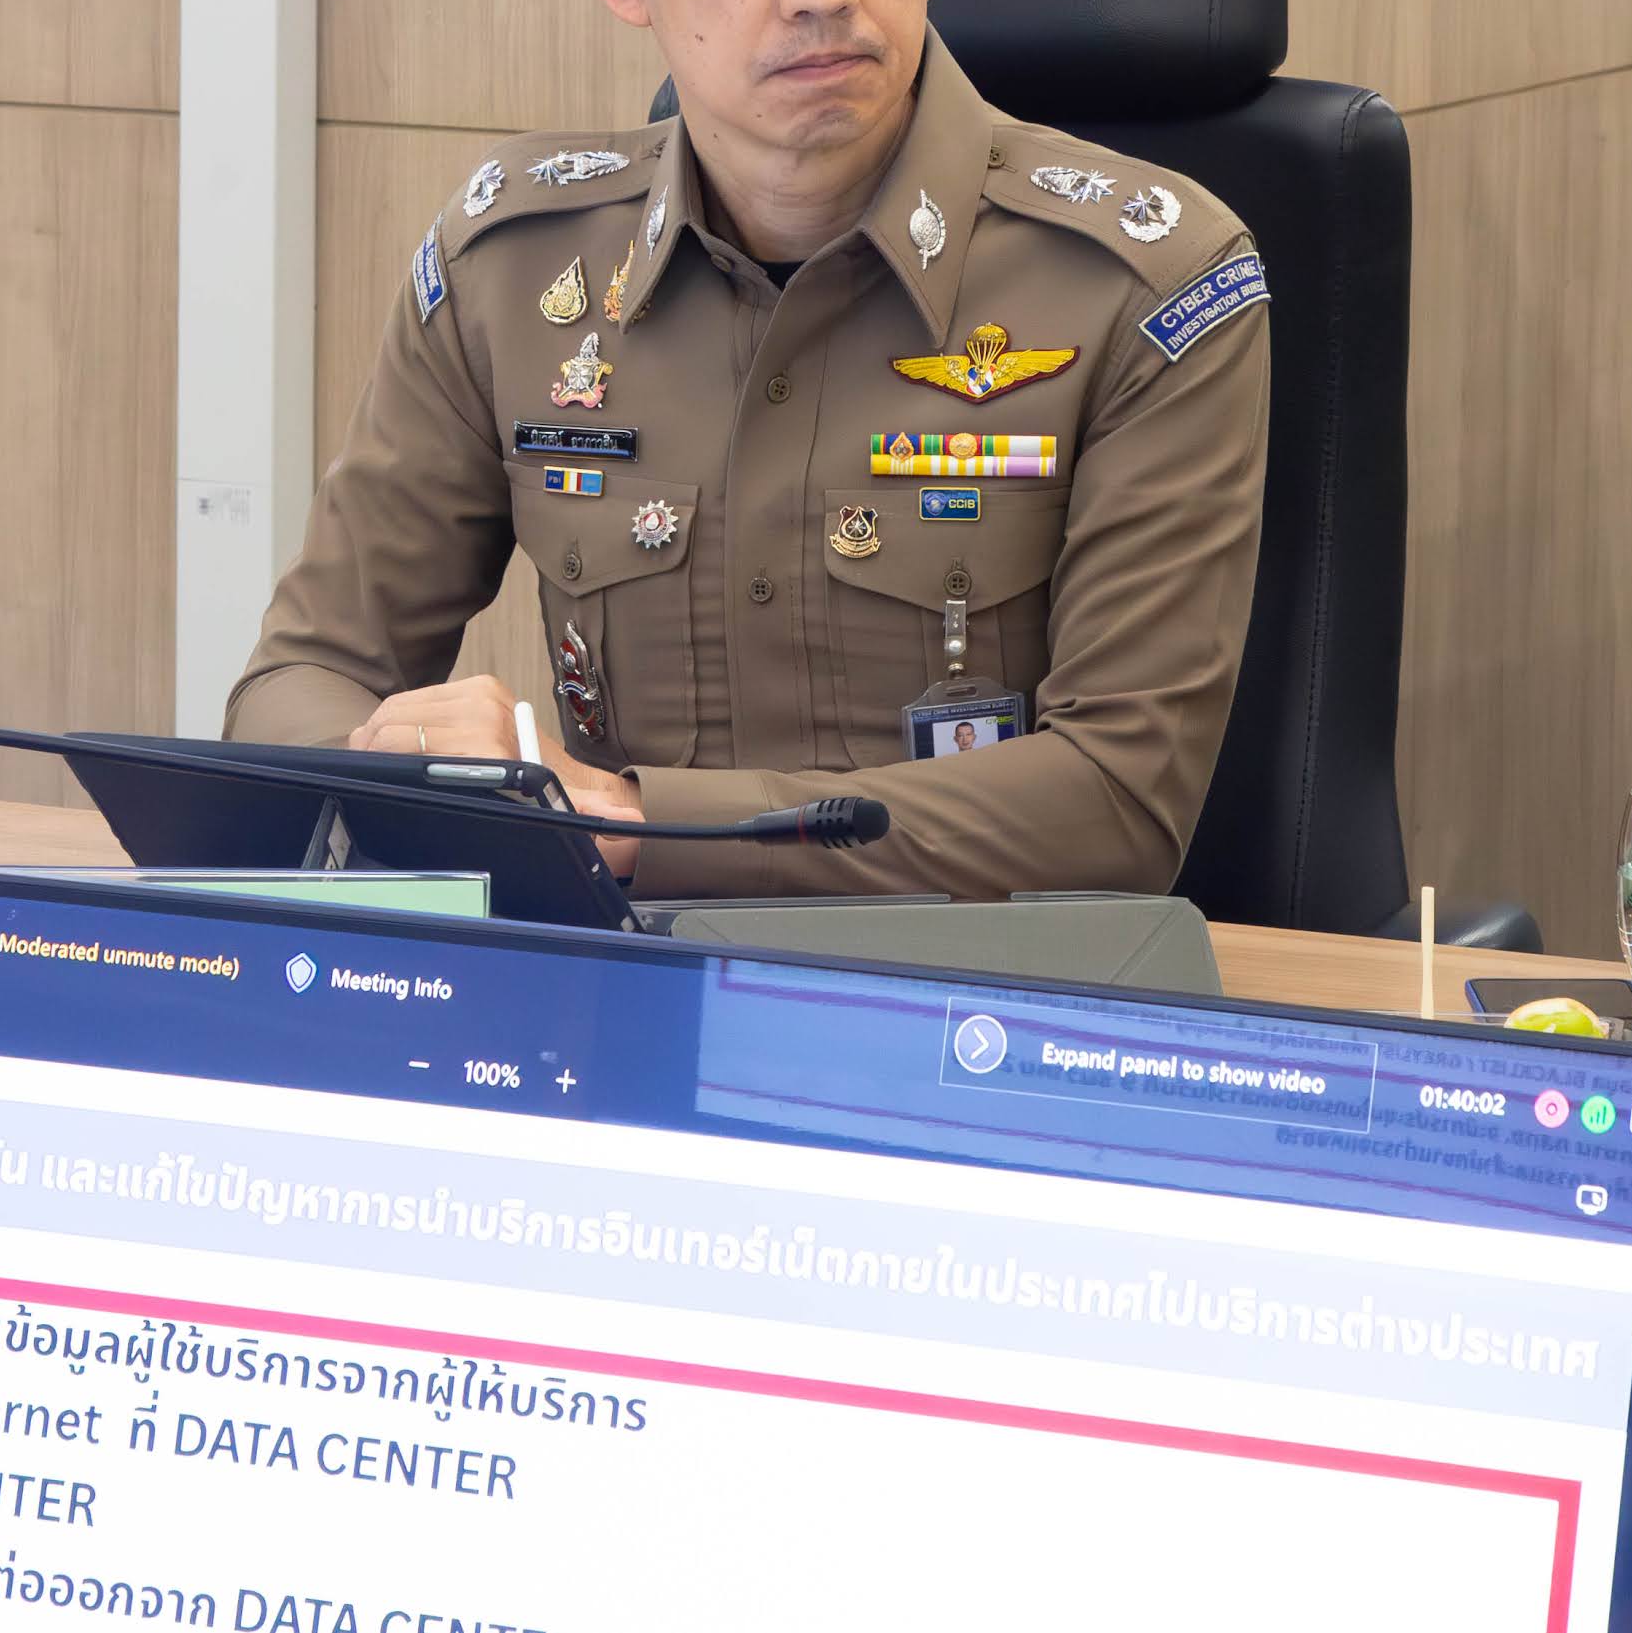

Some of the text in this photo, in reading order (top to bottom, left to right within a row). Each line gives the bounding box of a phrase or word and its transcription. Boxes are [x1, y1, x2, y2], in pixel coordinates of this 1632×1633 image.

[1160, 260, 1260, 329] CYBER CRIME
[1167, 290, 1242, 350] INVESTIGATION
[948, 498, 976, 510] CCIB
[103, 947, 175, 972] unmute
[179, 950, 241, 980] mode)
[330, 968, 453, 1002] Meeting Info
[462, 1058, 522, 1089] 100%
[1041, 1039, 1327, 1096] Expand panel to show video
[1419, 1085, 1507, 1117] 01:40:02
[127, 1390, 160, 1454] ที่
[174, 1411, 301, 1474] DATA
[316, 1433, 519, 1500] CENTER
[233, 1588, 362, 1633] DATA
